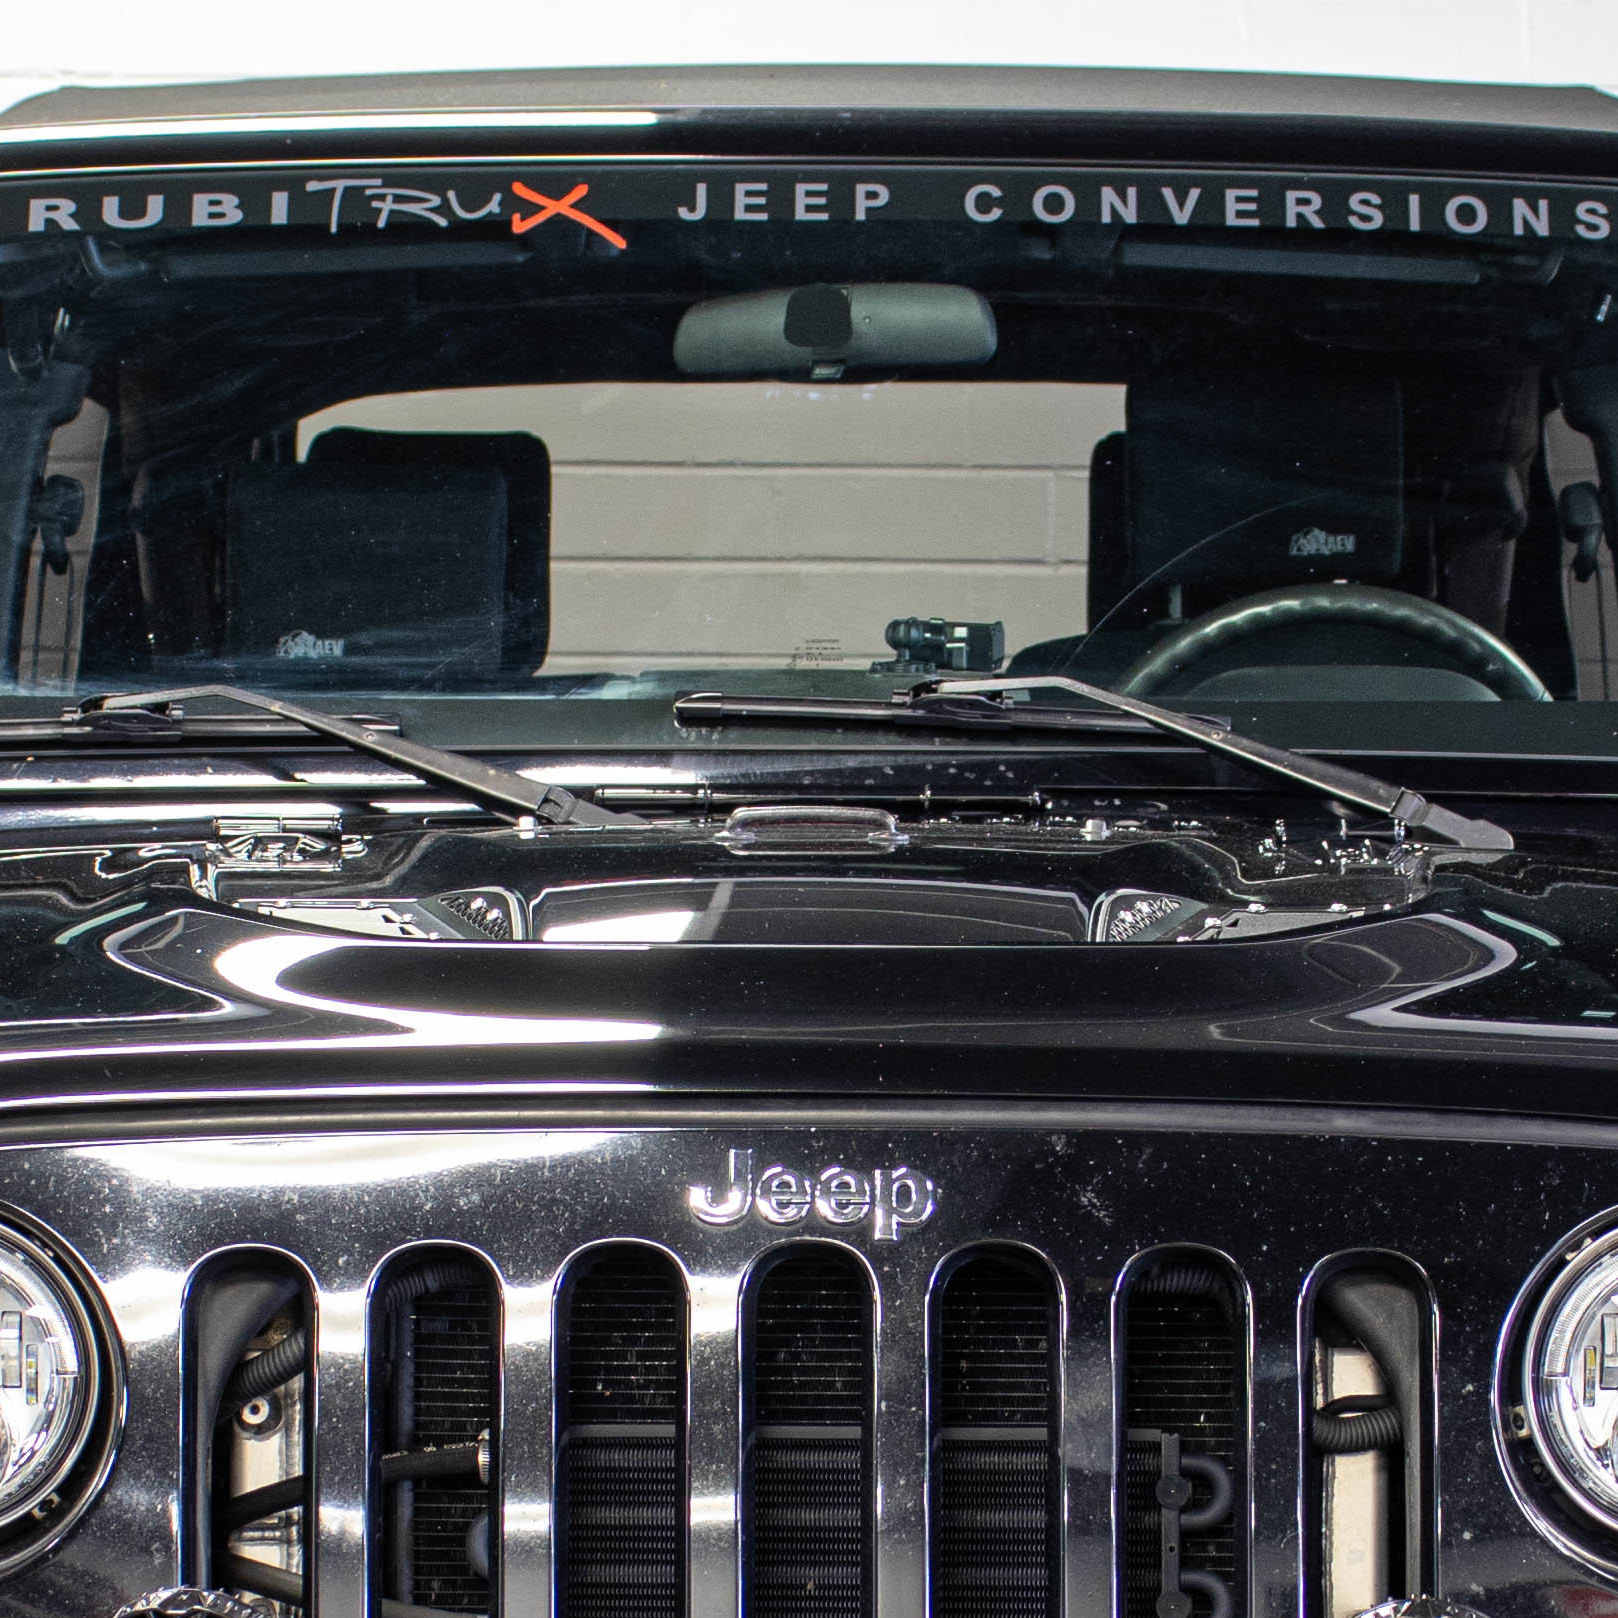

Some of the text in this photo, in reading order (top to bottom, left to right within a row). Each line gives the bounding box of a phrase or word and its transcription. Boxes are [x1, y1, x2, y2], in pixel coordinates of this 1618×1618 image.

[677, 181, 889, 221] JEEP
[963, 183, 1610, 239] CONVERSIONS
[688, 1147, 935, 1241] Jeep
